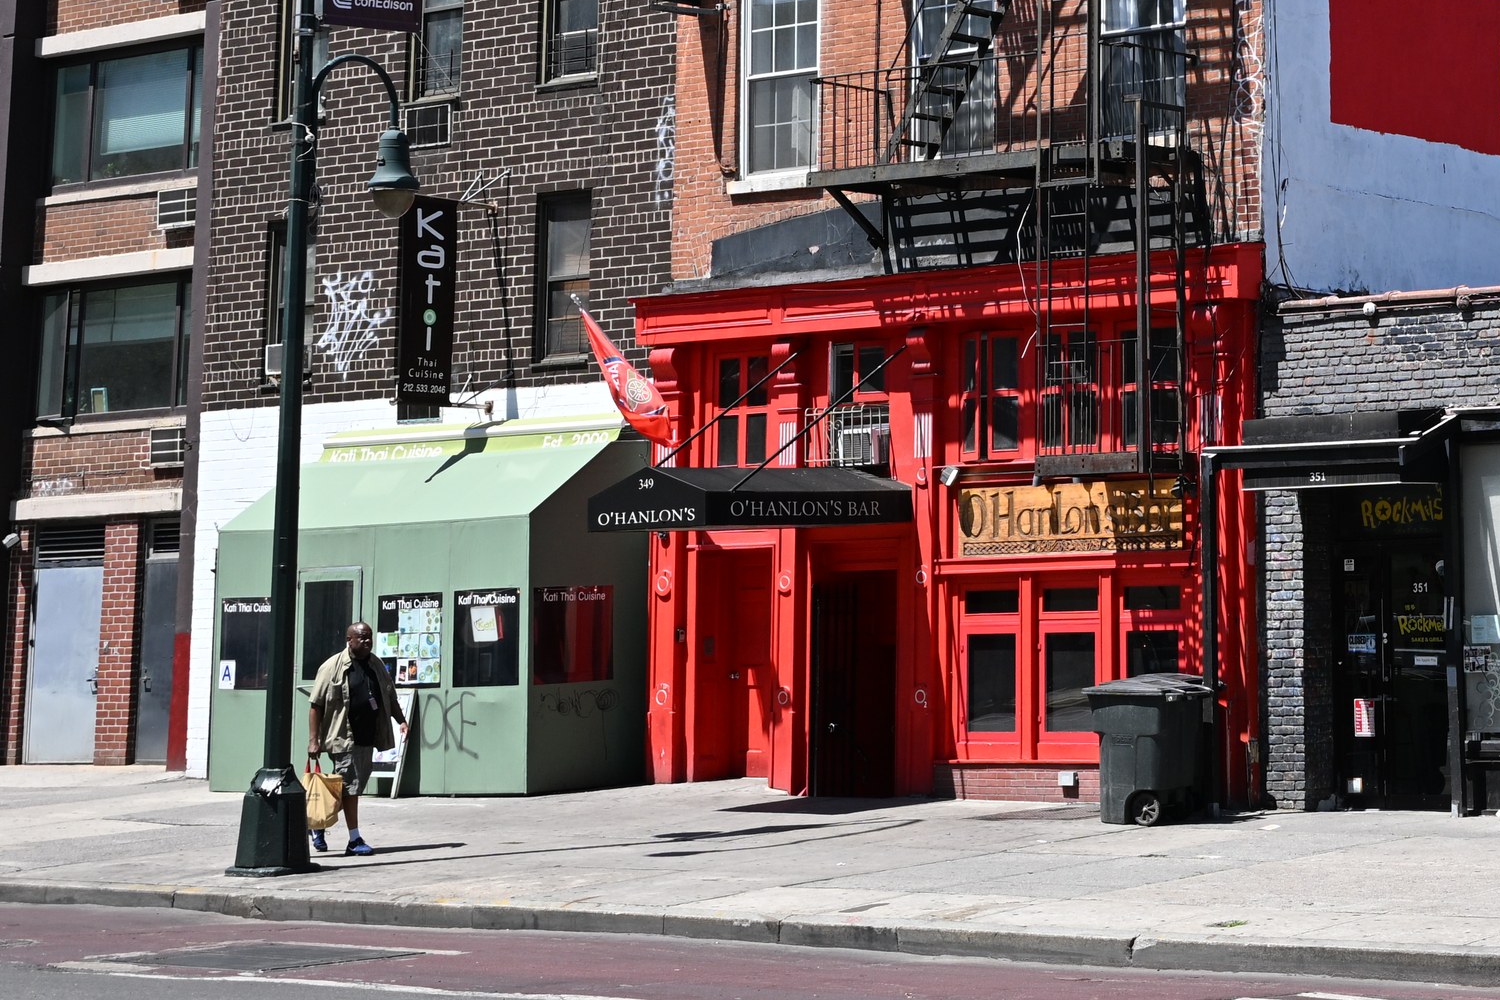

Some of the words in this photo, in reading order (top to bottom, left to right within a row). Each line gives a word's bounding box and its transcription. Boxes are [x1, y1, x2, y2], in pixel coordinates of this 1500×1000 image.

[417, 357, 437, 368] Thai
[403, 383, 446, 394] 212.533.2046
[330, 449, 357, 463] Kati
[361, 447, 388, 461] Thai
[391, 444, 442, 459] Cuisine
[1309, 472, 1326, 482] 351
[638, 478, 654, 490] 349
[730, 500, 842, 517] O'HANLON'S
[848, 500, 881, 516] BAR
[598, 507, 696, 526] O'HANLON'S
[1412, 582, 1429, 593] 351
[458, 595, 472, 606] Kati
[473, 594, 489, 605] Thai
[490, 592, 516, 604] Cuisine
[543, 591, 559, 602] Kati
[560, 591, 577, 602] Thai
[578, 590, 606, 602] Cuisine
[224, 602, 237, 612] Kati
[238, 602, 252, 612] Thai
[253, 602, 271, 612] Cuisi
[382, 600, 396, 611] Kati
[397, 599, 412, 610] Thai
[413, 598, 439, 610] Cuisine
[222, 665, 232, 682] A
